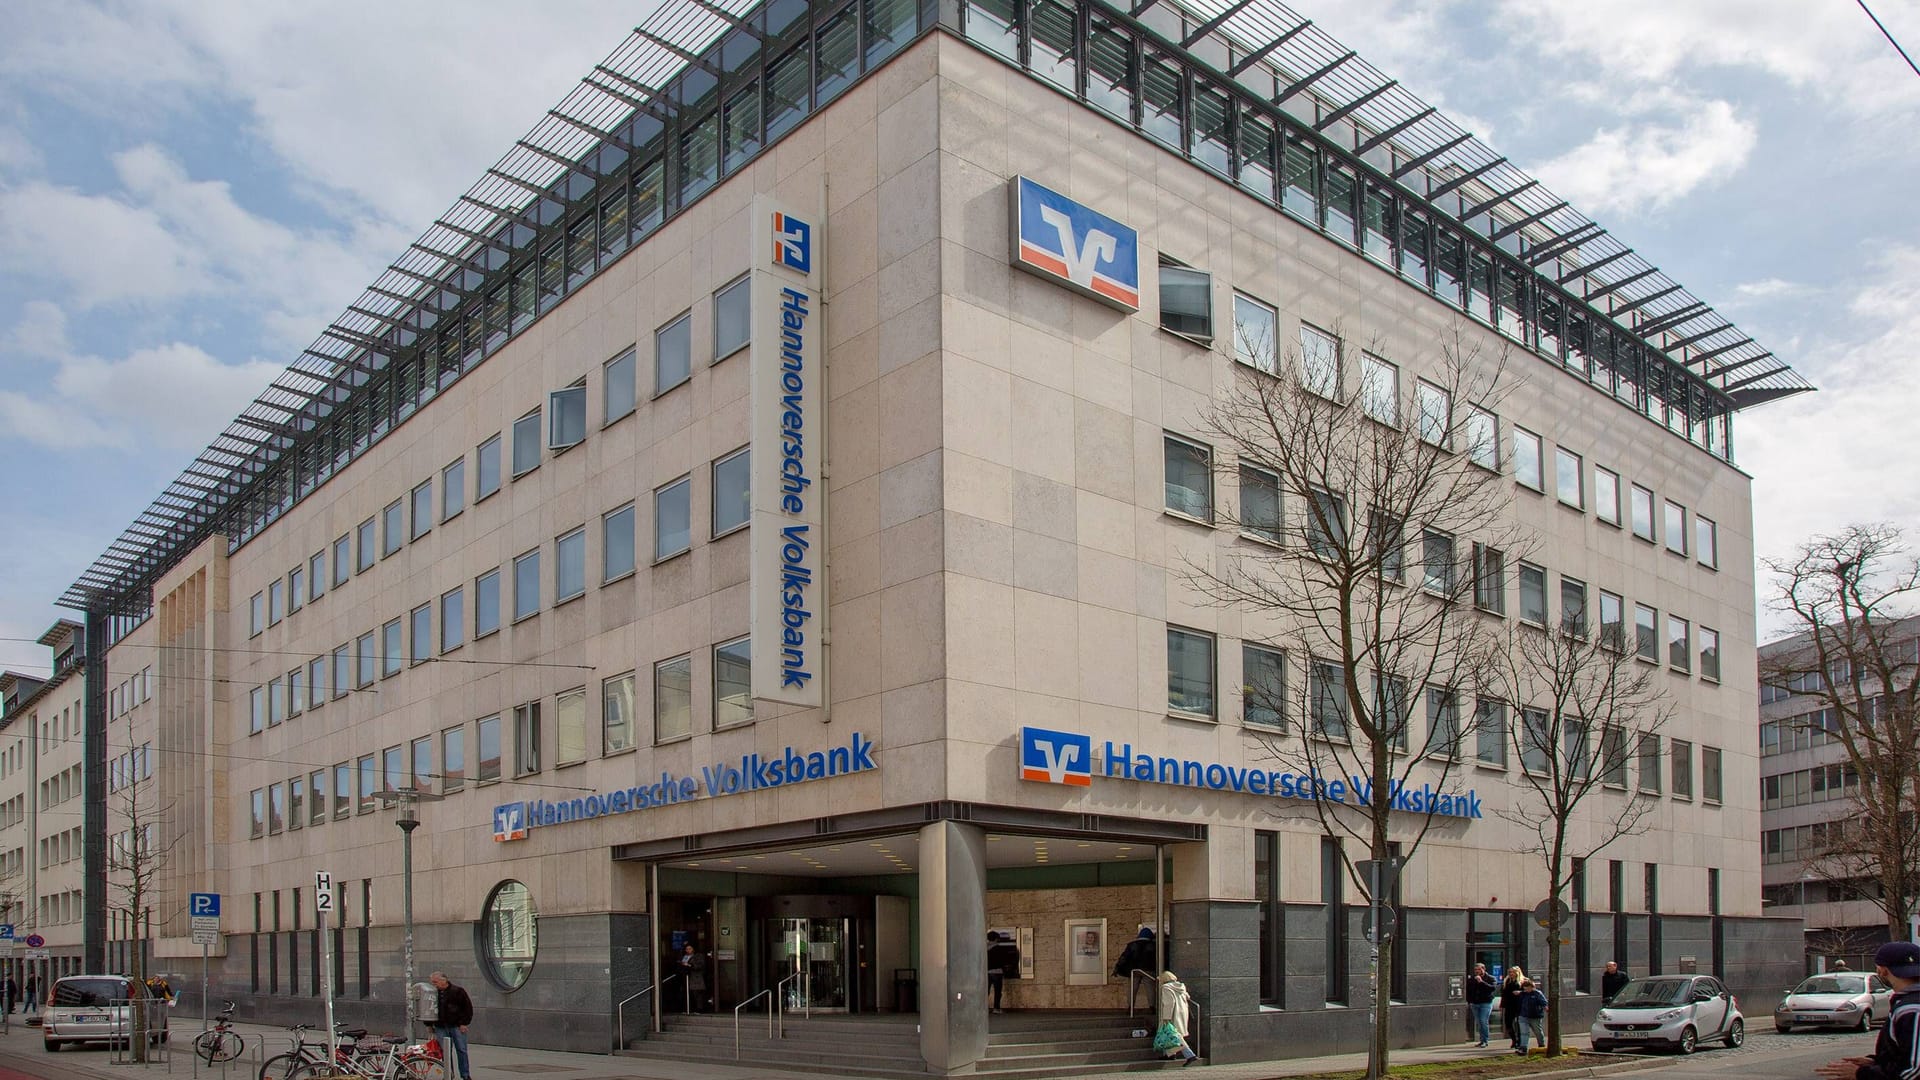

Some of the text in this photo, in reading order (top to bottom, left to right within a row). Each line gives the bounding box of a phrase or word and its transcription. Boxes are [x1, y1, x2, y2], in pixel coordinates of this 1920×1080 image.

[781, 286, 812, 690] Hannoversche Volksbank
[528, 731, 878, 828] Hannoversche Volksbank
[1103, 740, 1483, 819] Hannoversche Vlksbank
[195, 895, 212, 914] P
[317, 874, 331, 890] H
[318, 893, 331, 909] 2
